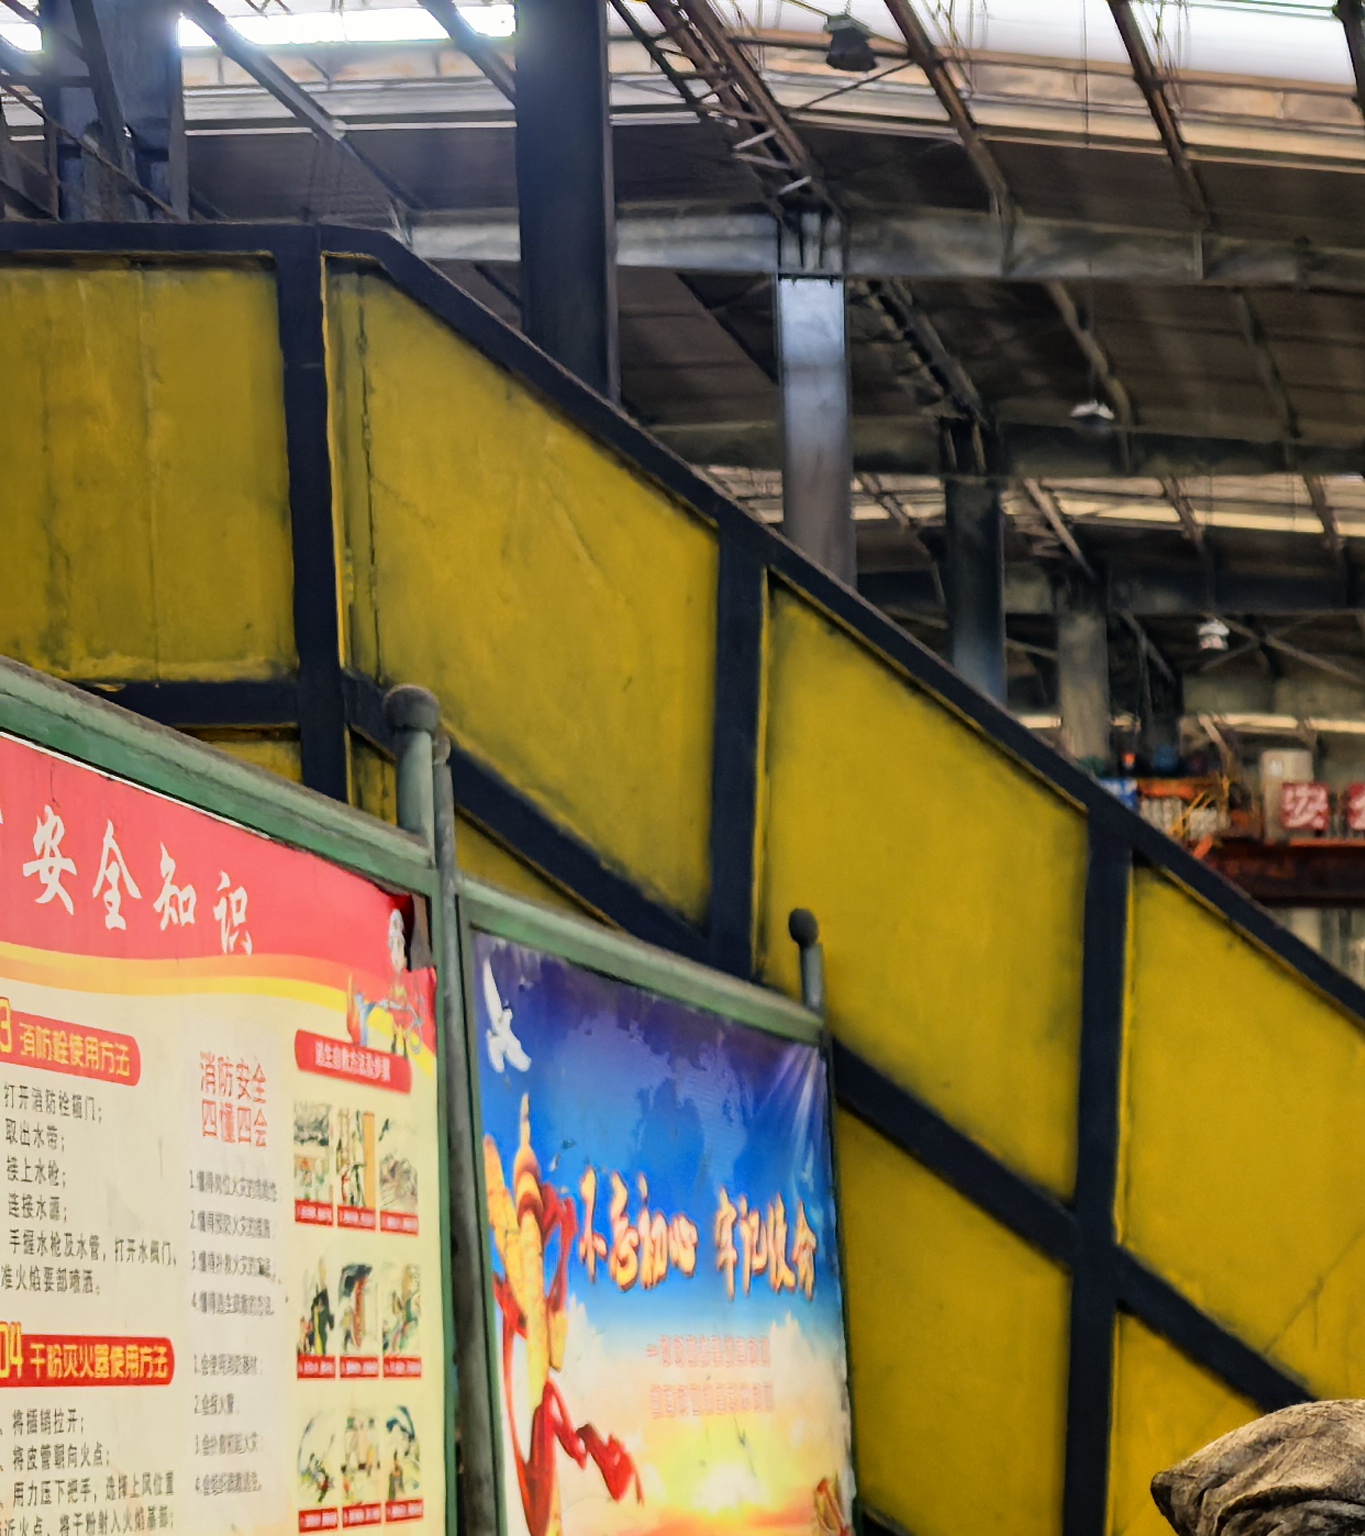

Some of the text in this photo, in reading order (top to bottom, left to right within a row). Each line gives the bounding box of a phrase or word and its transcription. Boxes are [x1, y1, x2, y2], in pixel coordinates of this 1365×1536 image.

[200, 1051, 266, 1103] 消防安全
[202, 1099, 267, 1148] 四懂四会
[579, 1165, 818, 1302] 不忘初心 牢记使命
[30, 1344, 168, 1378] 干粉灭火器使用方法
